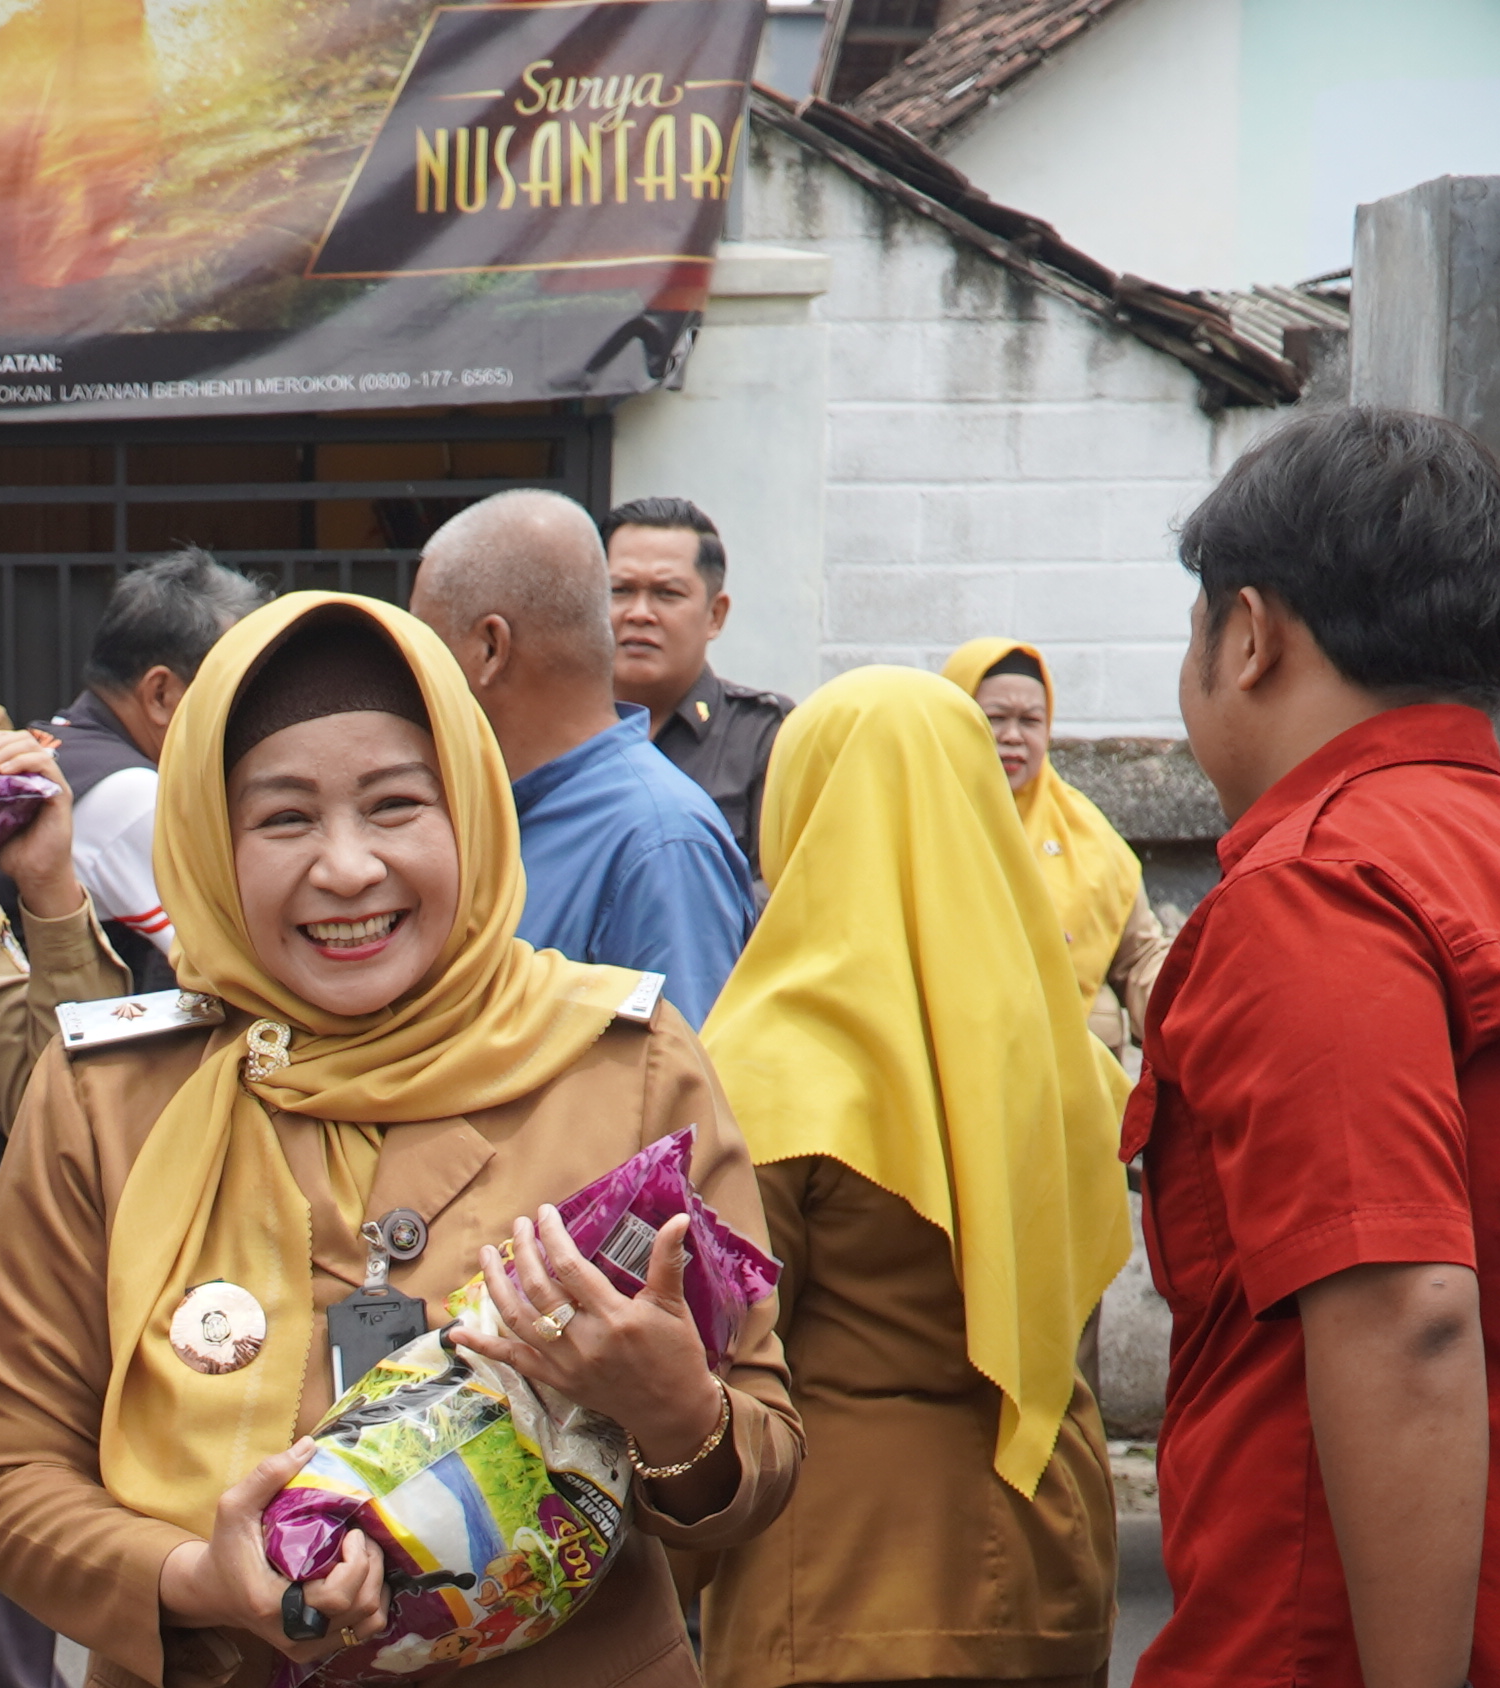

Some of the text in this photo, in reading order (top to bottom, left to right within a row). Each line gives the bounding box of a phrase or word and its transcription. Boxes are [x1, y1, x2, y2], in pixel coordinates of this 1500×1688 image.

[514, 60, 684, 132] Surya
[59, 382, 149, 401] LAYANAN
[152, 379, 252, 399] BERHENTI
[254, 374, 356, 396] MEROKOK
